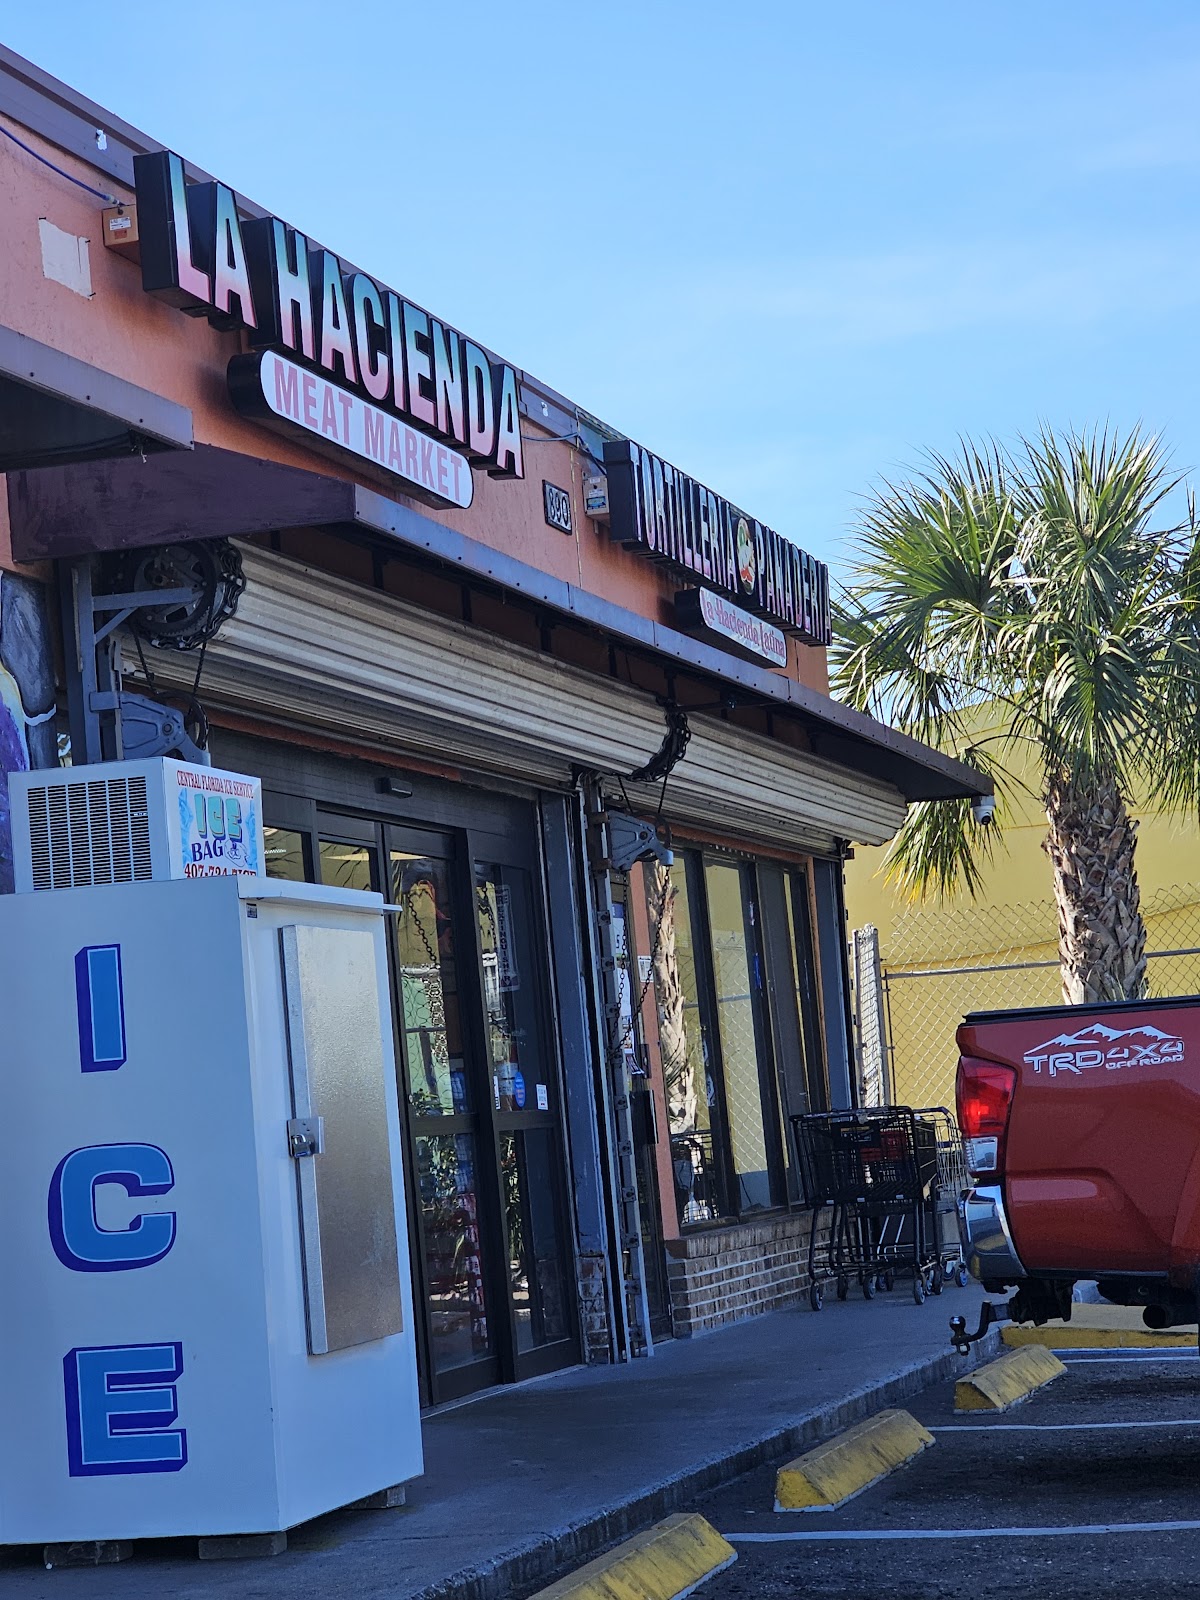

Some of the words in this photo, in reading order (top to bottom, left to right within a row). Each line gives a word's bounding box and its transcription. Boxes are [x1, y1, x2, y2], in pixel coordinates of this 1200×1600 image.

[168, 150, 258, 329] LA
[271, 217, 524, 479] HACIENDA
[274, 357, 353, 446] MEAT
[363, 404, 462, 501] MARKET
[548, 487, 569, 528] 890
[629, 439, 739, 595] TORTILLERIA
[754, 519, 833, 646] PANADERIA
[701, 589, 714, 627] La
[715, 597, 760, 647] Hacienda
[759, 621, 786, 659] Latina
[177, 770, 202, 789] CENTRAL
[201, 774, 225, 793] FLORIDA
[223, 779, 233, 795] ICE
[232, 780, 254, 799] SERVICE
[194, 793, 243, 843] ICE
[191, 840, 224, 862] BAG
[1023, 1050, 1105, 1078] TRD
[47, 943, 189, 1478] ICE
